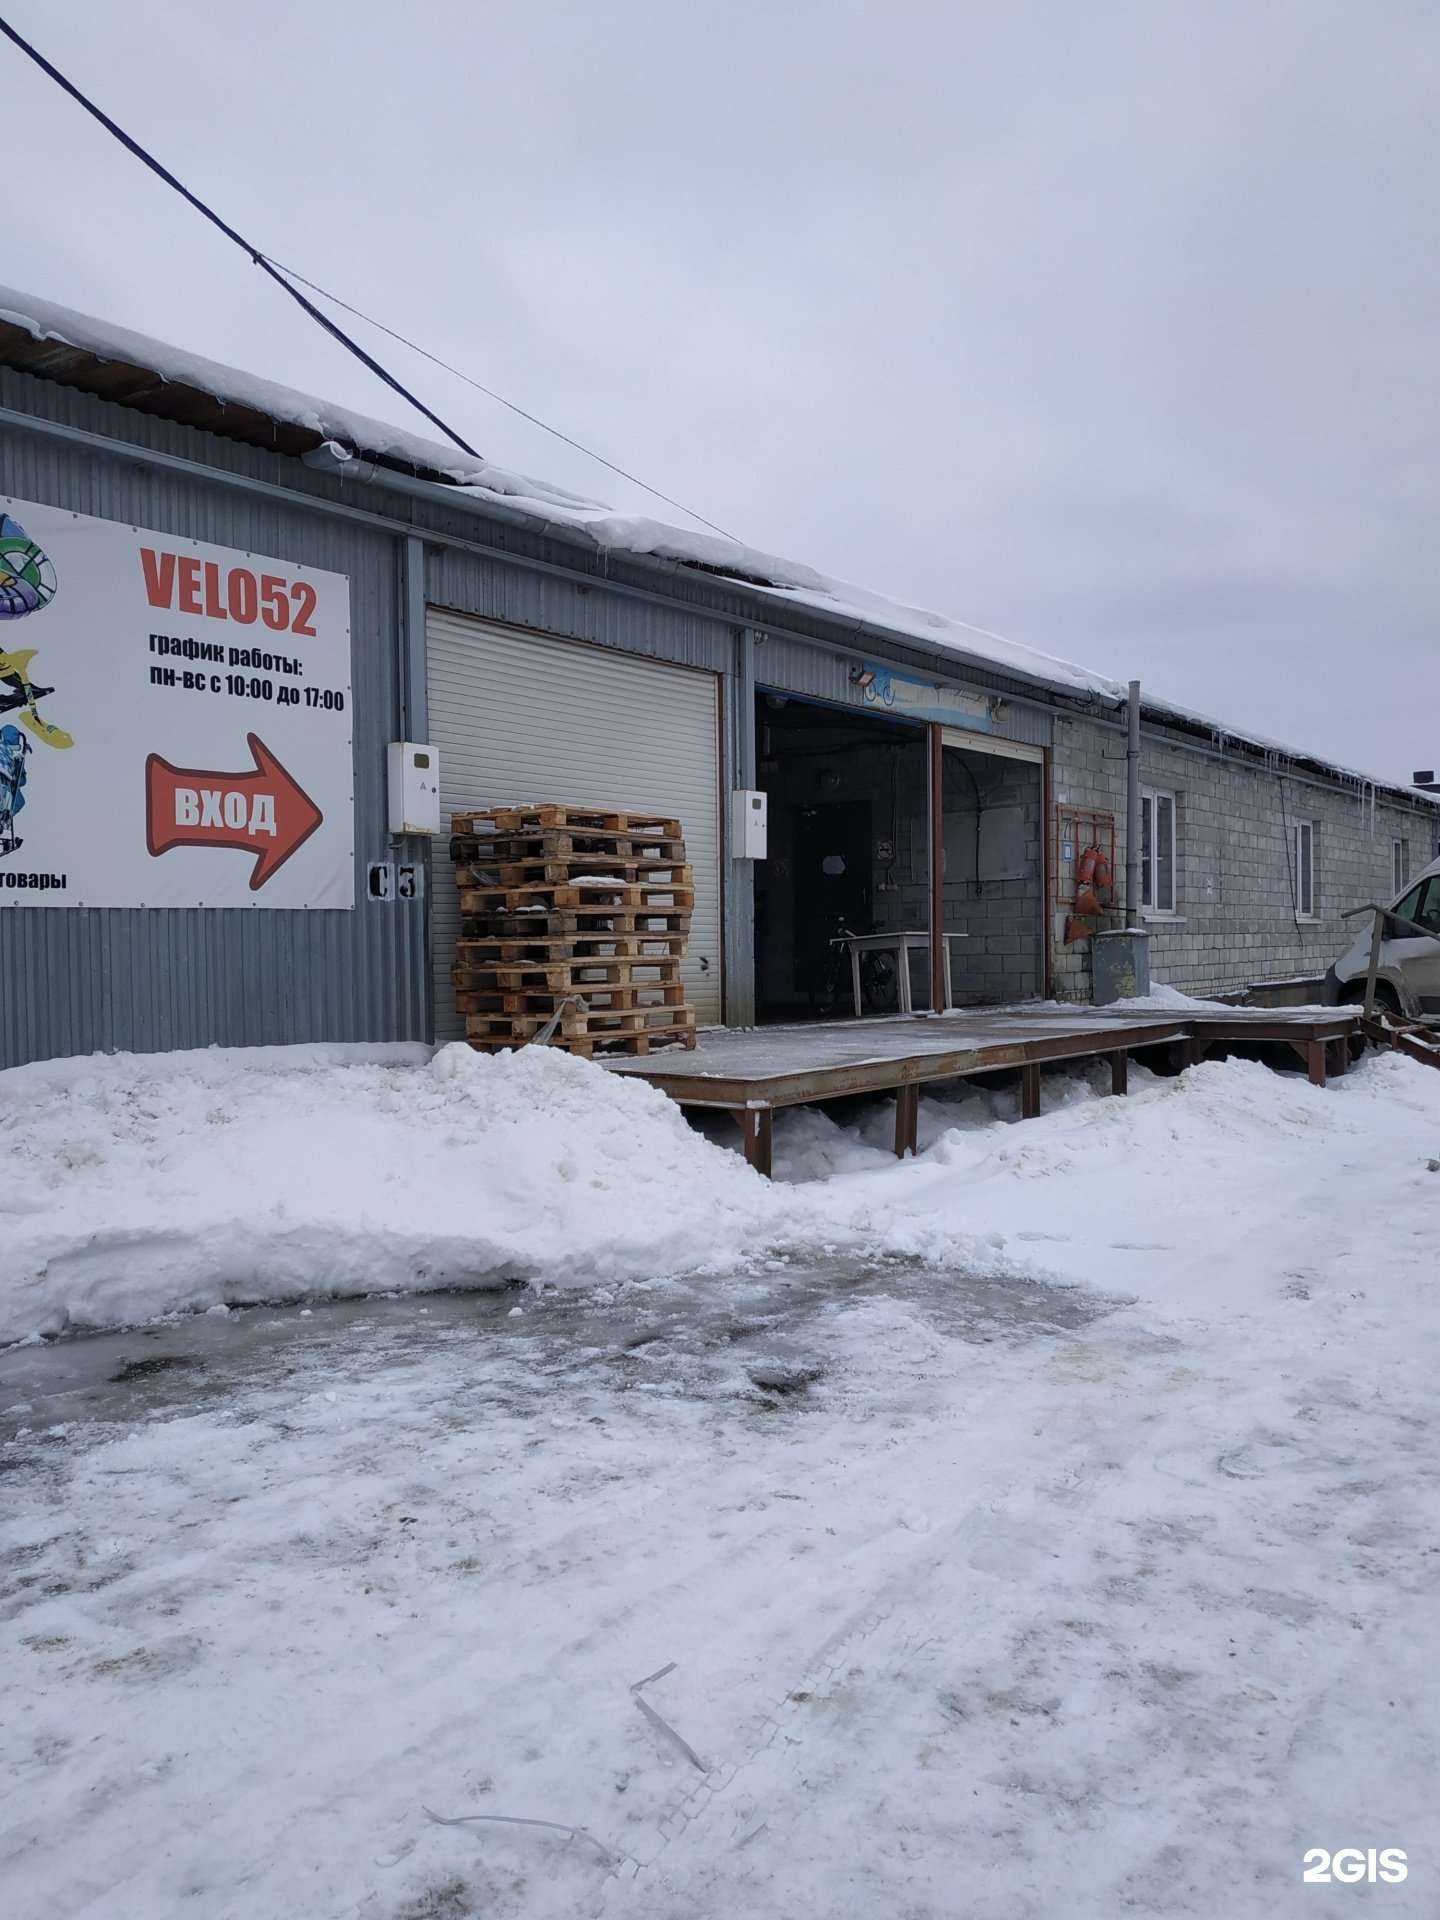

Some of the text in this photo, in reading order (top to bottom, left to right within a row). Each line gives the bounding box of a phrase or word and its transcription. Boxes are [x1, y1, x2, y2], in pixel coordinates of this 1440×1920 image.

[140, 547, 317, 637] VELO52
[149, 633, 303, 676] график работы:
[225, 674, 274, 700] 10:00
[276, 685, 301, 706] до
[303, 687, 345, 711] 17:00
[174, 787, 277, 837] ВХОД
